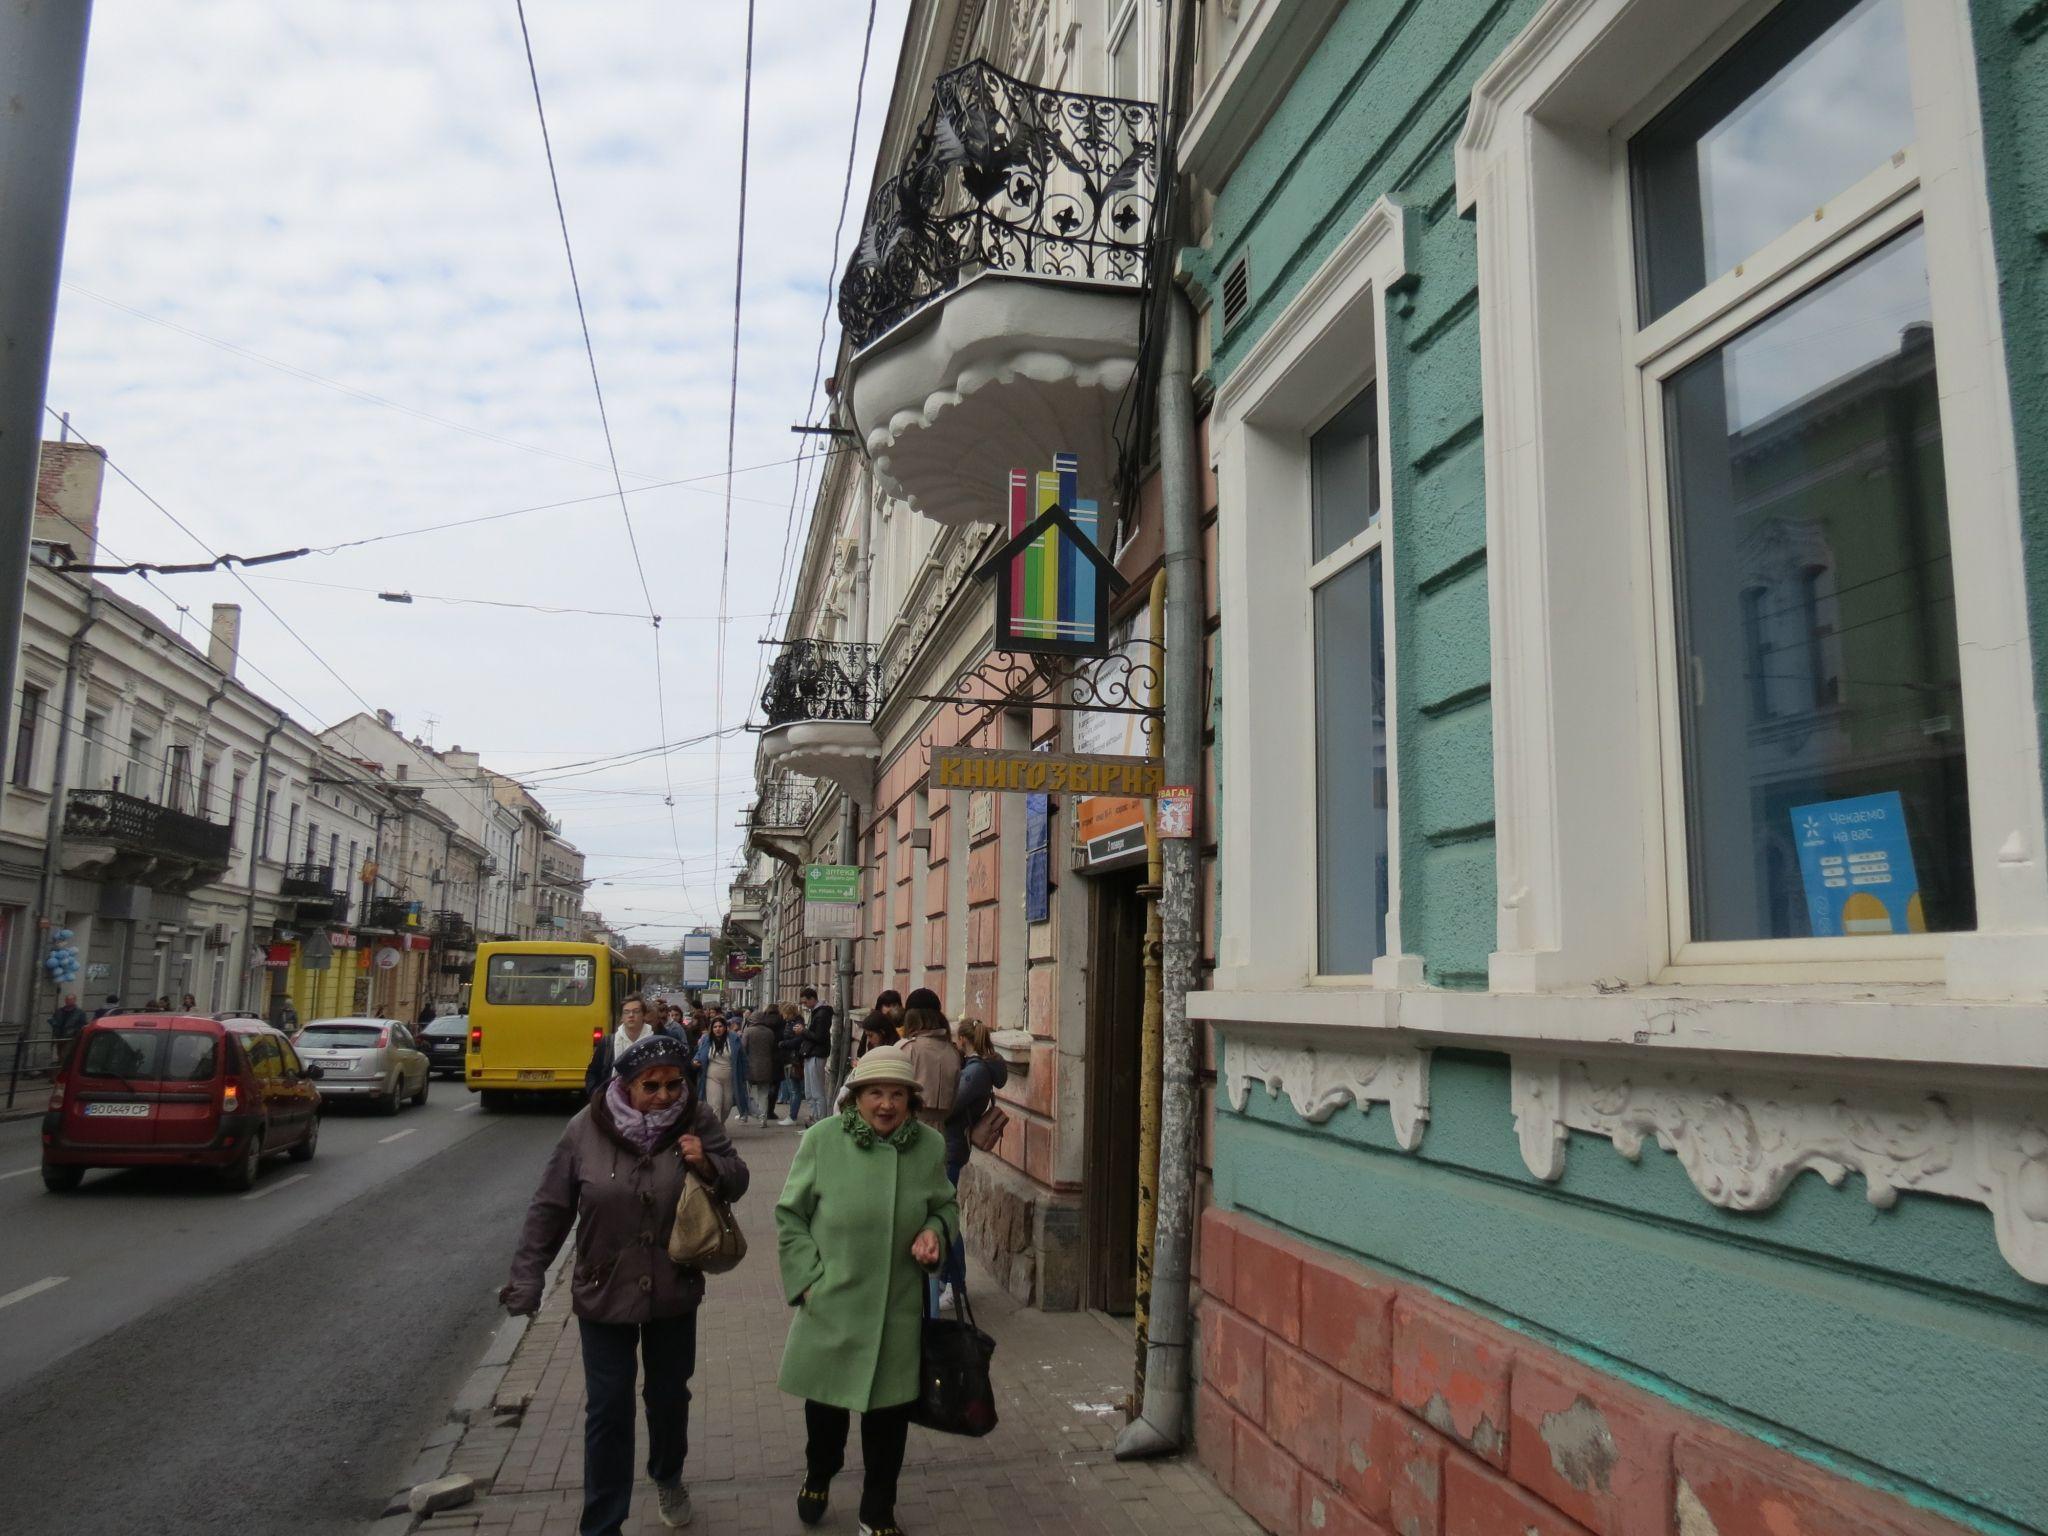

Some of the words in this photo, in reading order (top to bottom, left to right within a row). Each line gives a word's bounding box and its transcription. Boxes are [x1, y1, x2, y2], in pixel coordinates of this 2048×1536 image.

[940, 757, 1164, 795] КНИГОЗБІРНЯ
[1829, 809, 1884, 824] Чекаємо
[1833, 831, 1848, 842] на
[1850, 829, 1872, 841] вас
[576, 963, 587, 976] 15
